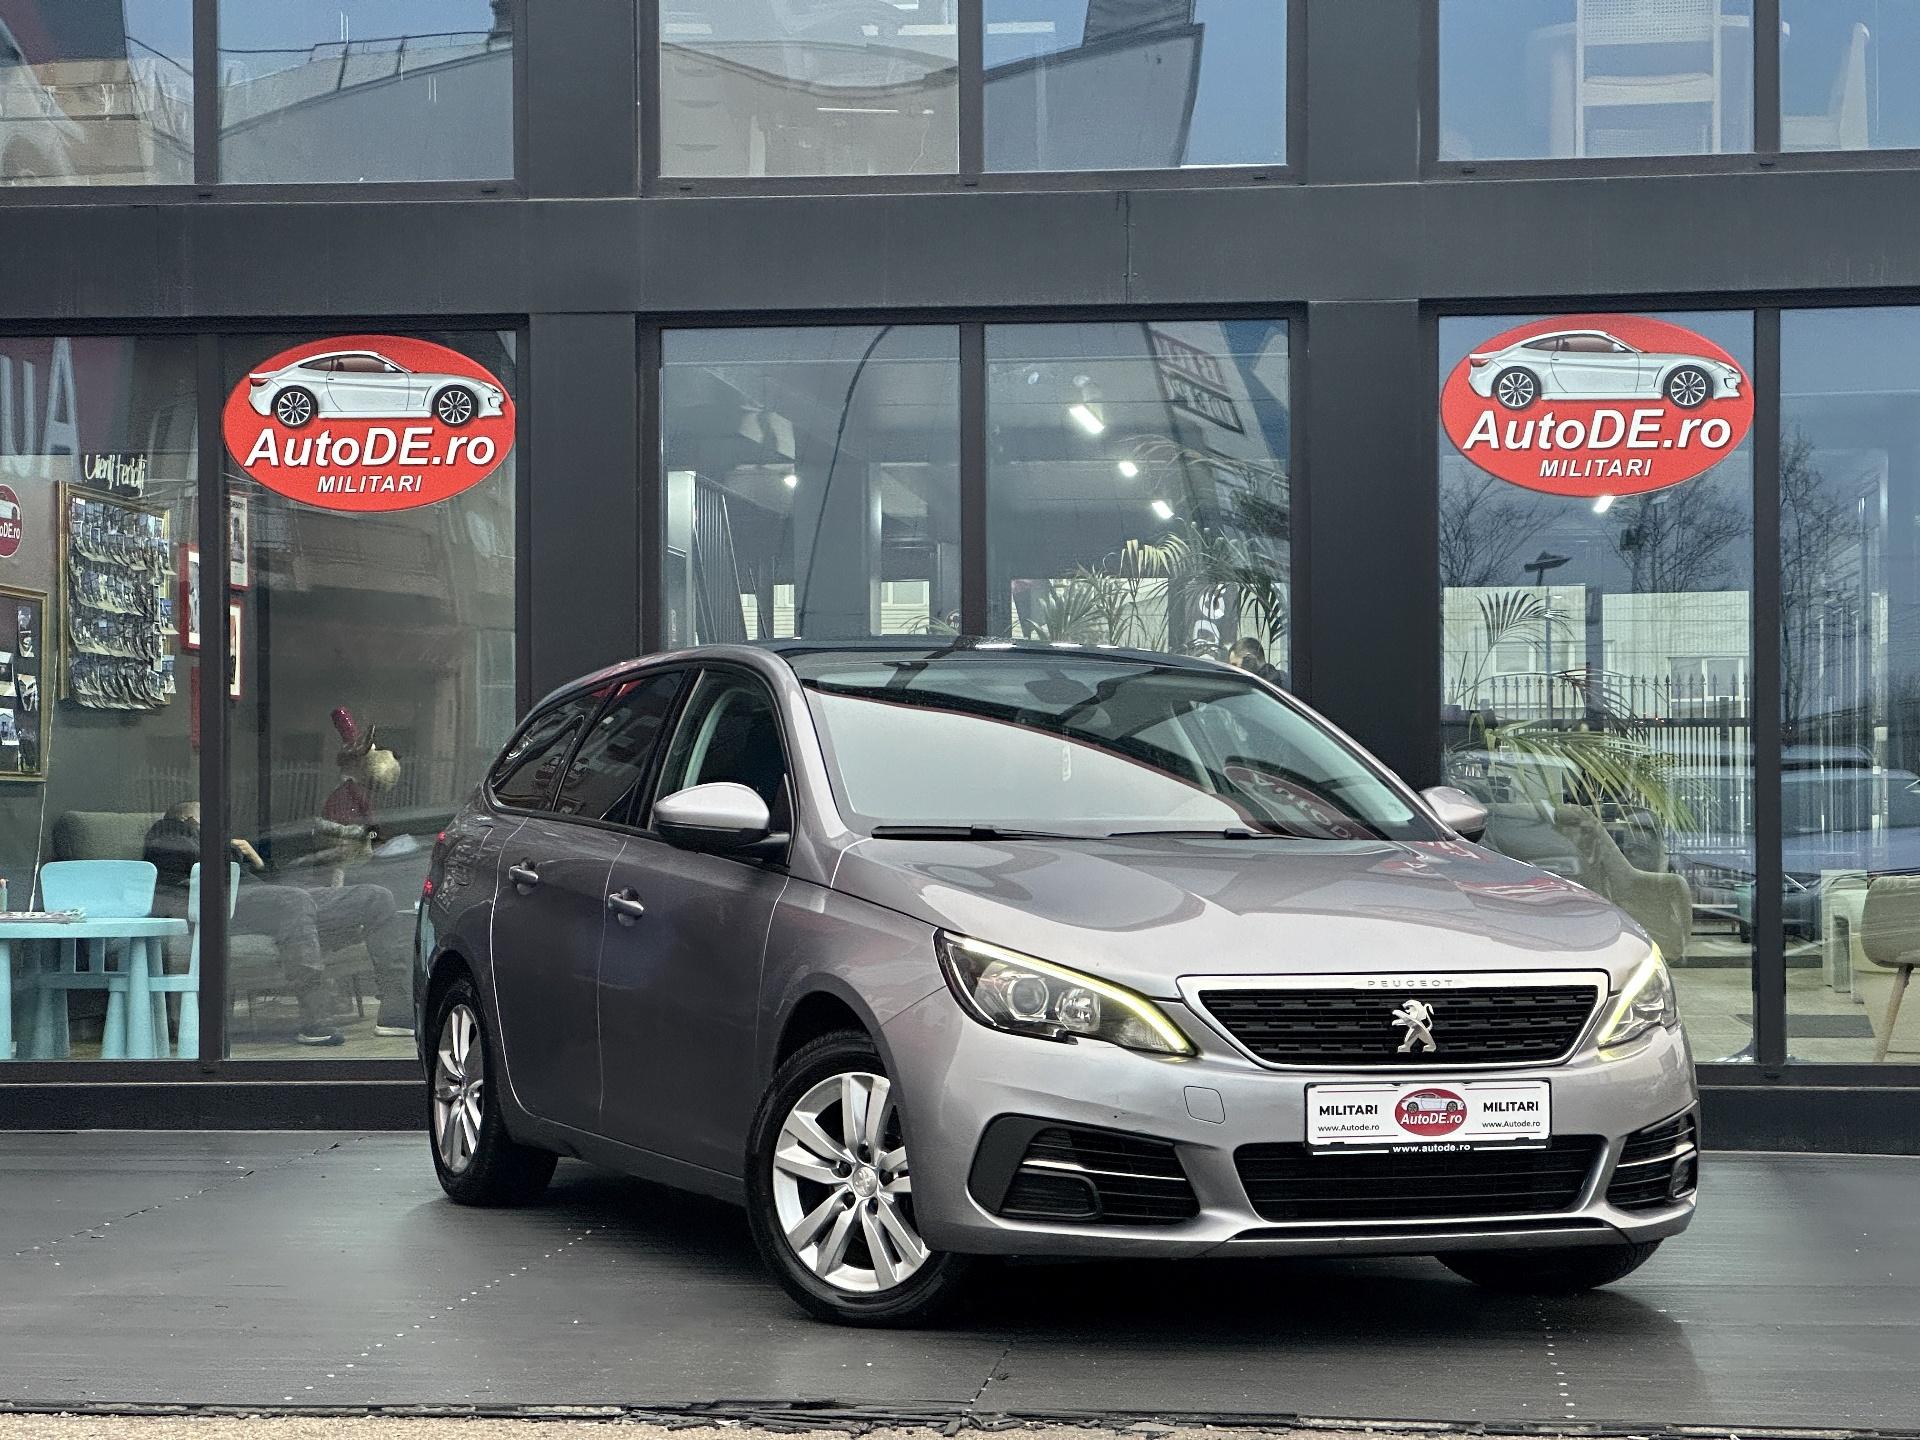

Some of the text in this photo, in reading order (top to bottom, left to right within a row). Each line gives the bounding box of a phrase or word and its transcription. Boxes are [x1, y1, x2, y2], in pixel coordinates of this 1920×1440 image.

[1463, 408, 1731, 450] AutoDE.ro
[244, 426, 496, 467] AutoDE.ro
[1539, 458, 1652, 477] MILITARI
[317, 475, 423, 493] MILITARI
[1367, 979, 1453, 988] PEUGEOT
[1319, 1104, 1378, 1116] MILITARI
[1483, 1101, 1539, 1113] MILITARI
[1400, 1112, 1463, 1125] AutoDE.ro
[1482, 1120, 1541, 1128] www.Autode.ro
[1318, 1123, 1380, 1132] www.Autode.ro
[1392, 1143, 1471, 1153] www.autode.ro
